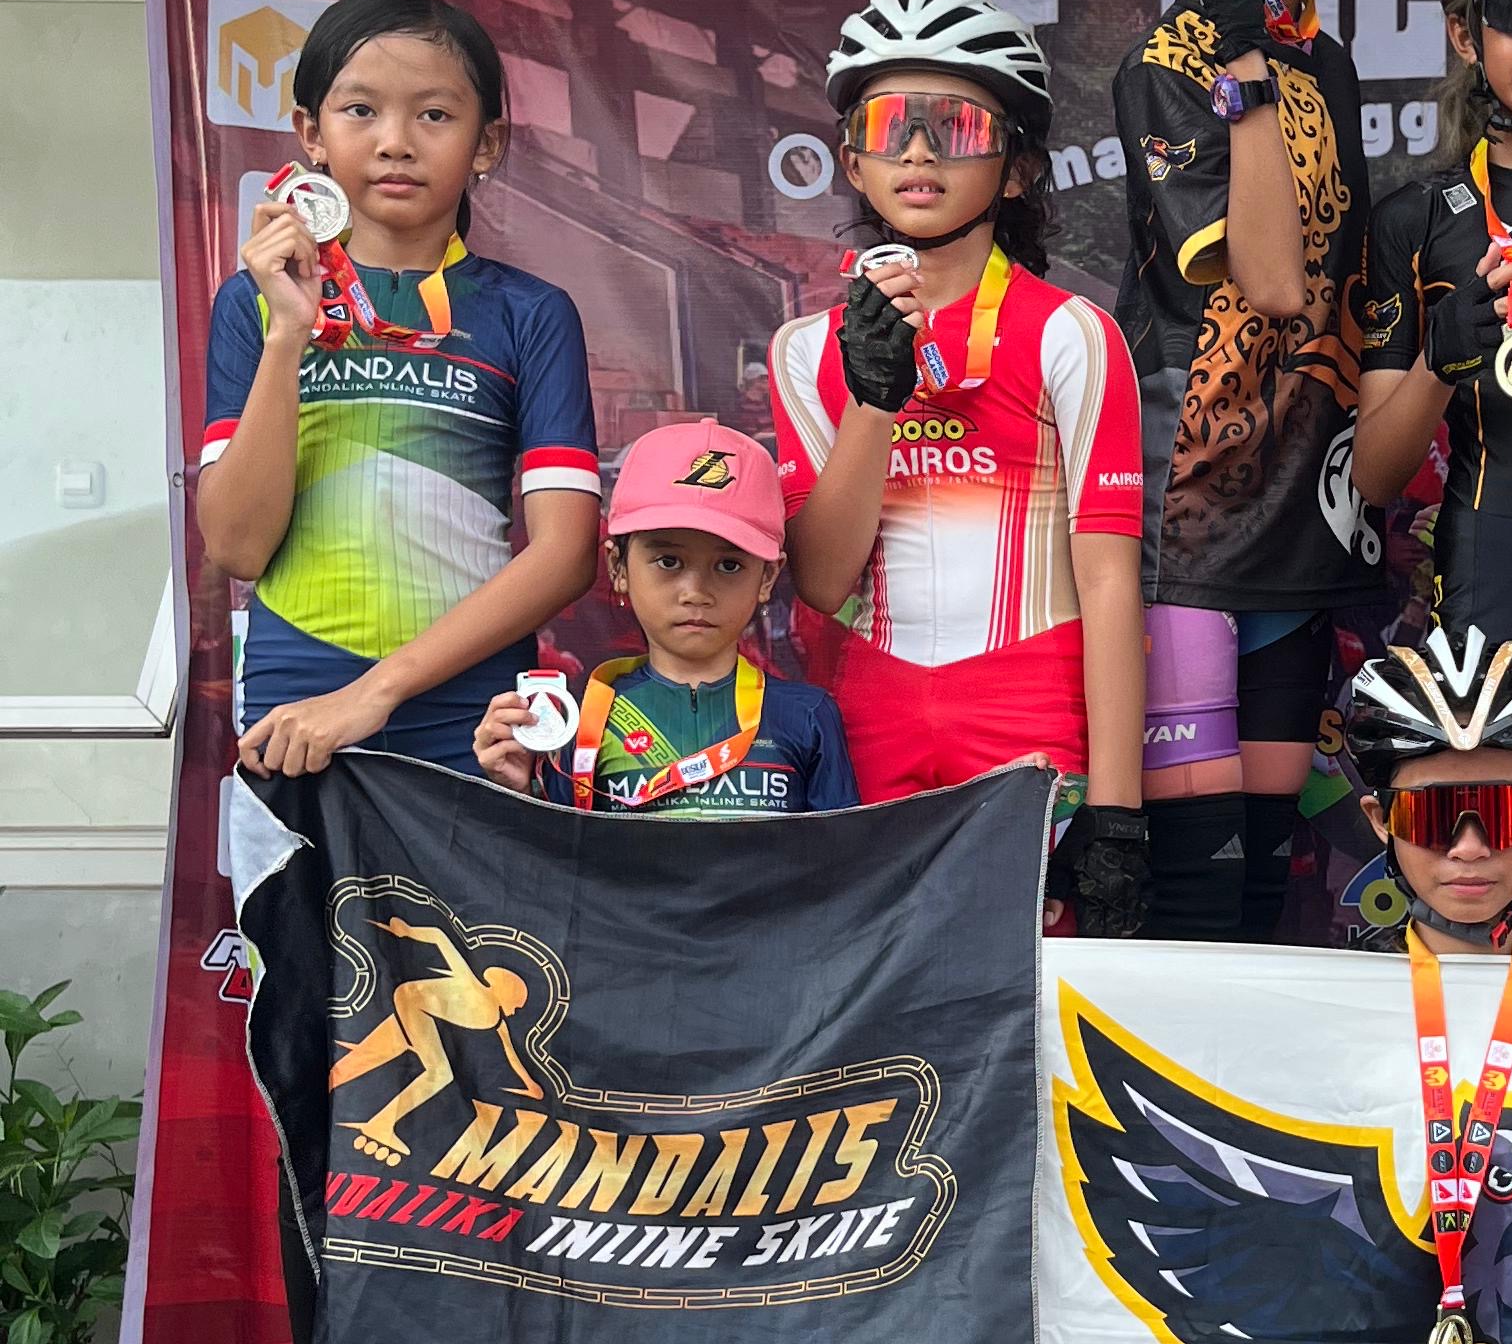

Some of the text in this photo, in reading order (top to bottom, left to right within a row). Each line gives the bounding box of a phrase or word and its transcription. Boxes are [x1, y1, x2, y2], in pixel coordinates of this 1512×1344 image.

[298, 356, 479, 393] MANDALIS
[430, 389, 477, 404] SKATE
[889, 445, 998, 476] AIROS
[607, 770, 789, 802] MADALIS
[694, 795, 746, 807] INLINE
[749, 798, 788, 809] SKATE
[430, 1097, 899, 1218] MANDALIS
[525, 1216, 739, 1268] INLINE
[742, 1196, 917, 1268] SKATE
